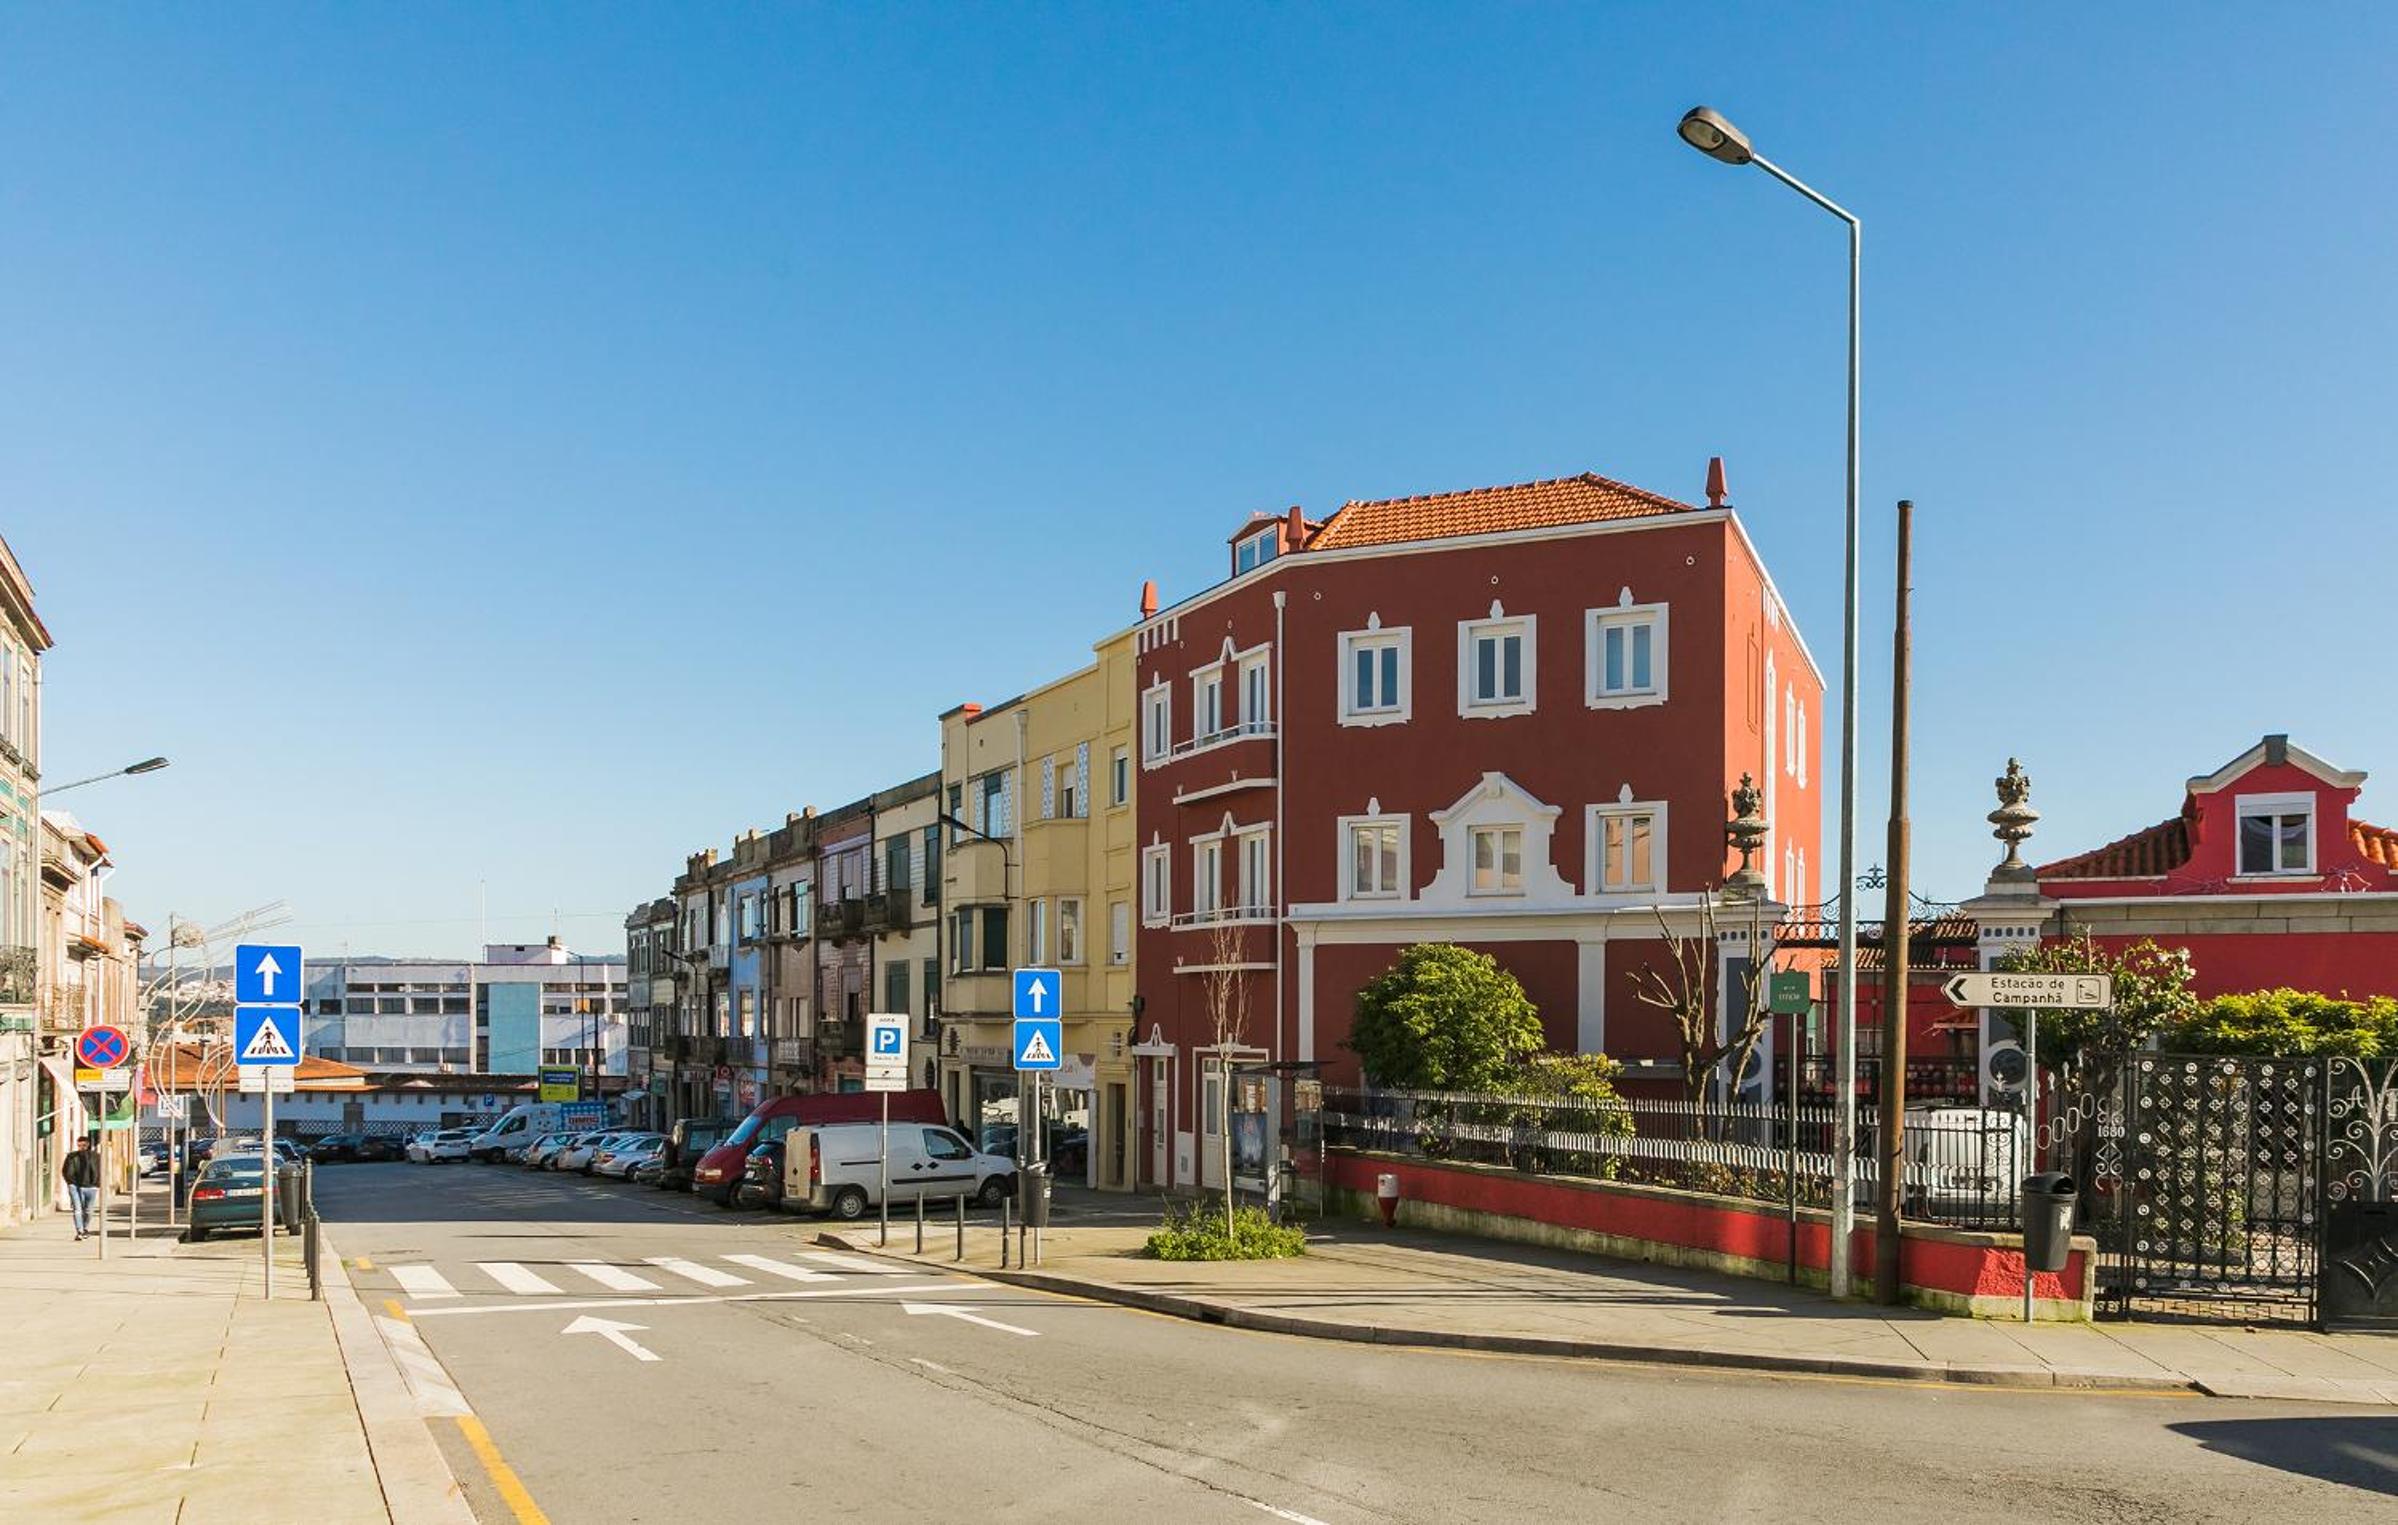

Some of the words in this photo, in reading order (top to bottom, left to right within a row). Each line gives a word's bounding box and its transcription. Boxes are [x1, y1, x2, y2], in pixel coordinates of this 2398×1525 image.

[2048, 978, 2065, 989] de
[1993, 992, 2063, 1005] Campanhã
[880, 1030, 896, 1051] P
[2097, 1126, 2126, 1138] 1680
